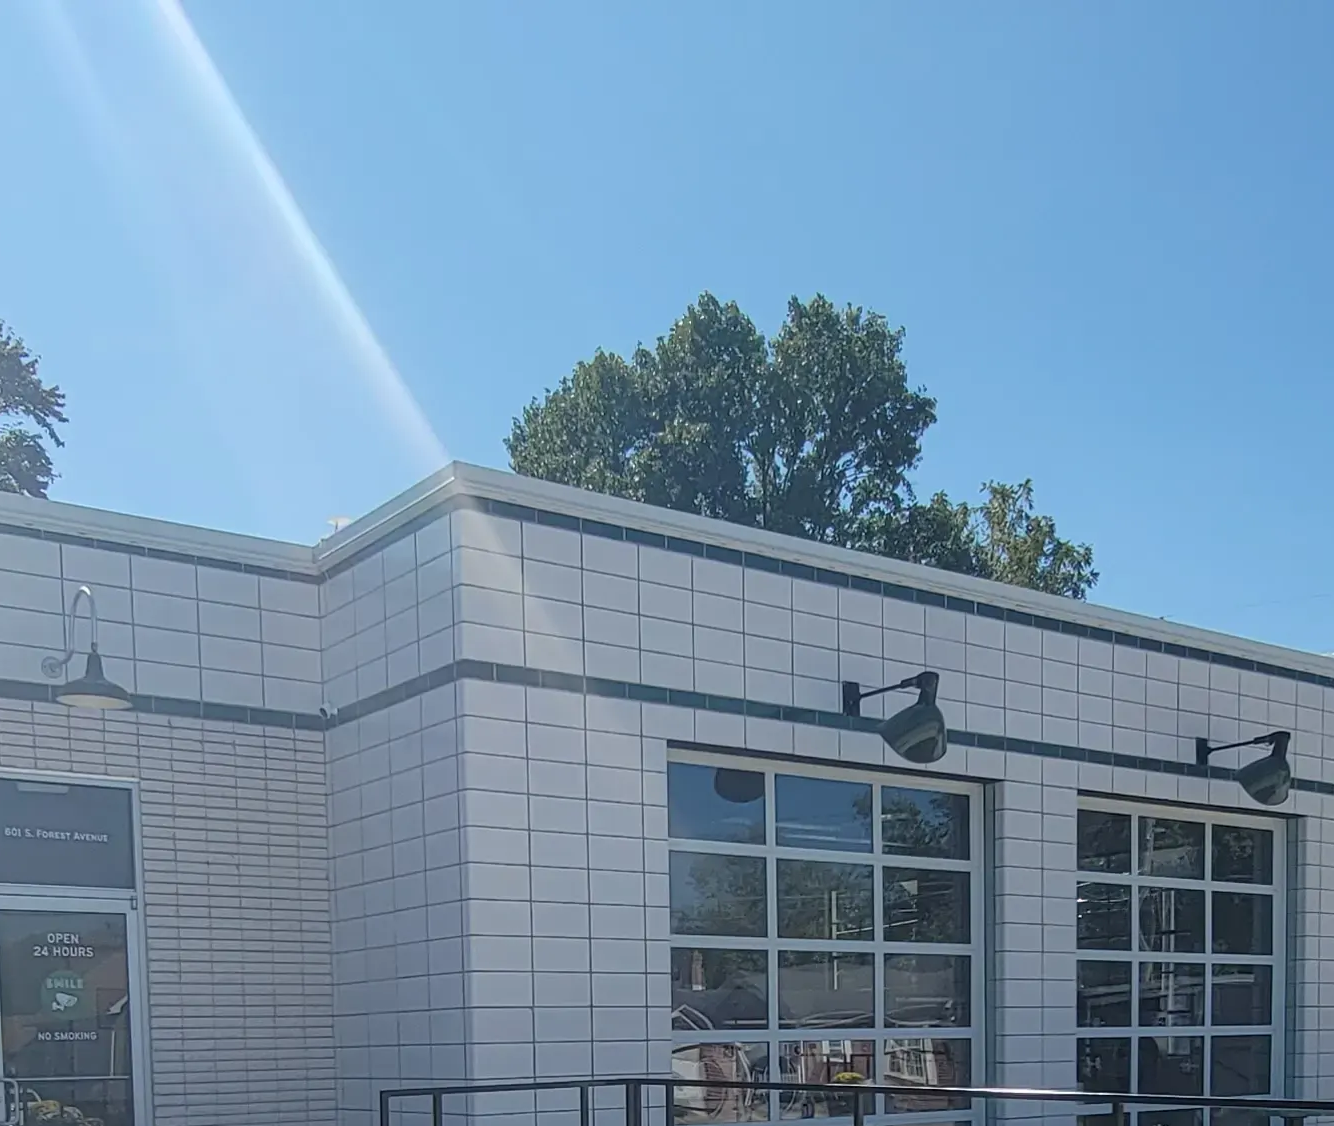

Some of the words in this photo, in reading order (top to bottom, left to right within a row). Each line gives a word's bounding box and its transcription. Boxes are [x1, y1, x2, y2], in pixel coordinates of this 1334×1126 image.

[36, 829, 71, 841] FOREST
[73, 832, 108, 843] AVENUE
[47, 933, 79, 944] OPEN
[33, 946, 49, 957] 24
[53, 947, 94, 957] HOURS
[38, 1032, 51, 1040] NO
[54, 1032, 97, 1040] SMOKING
